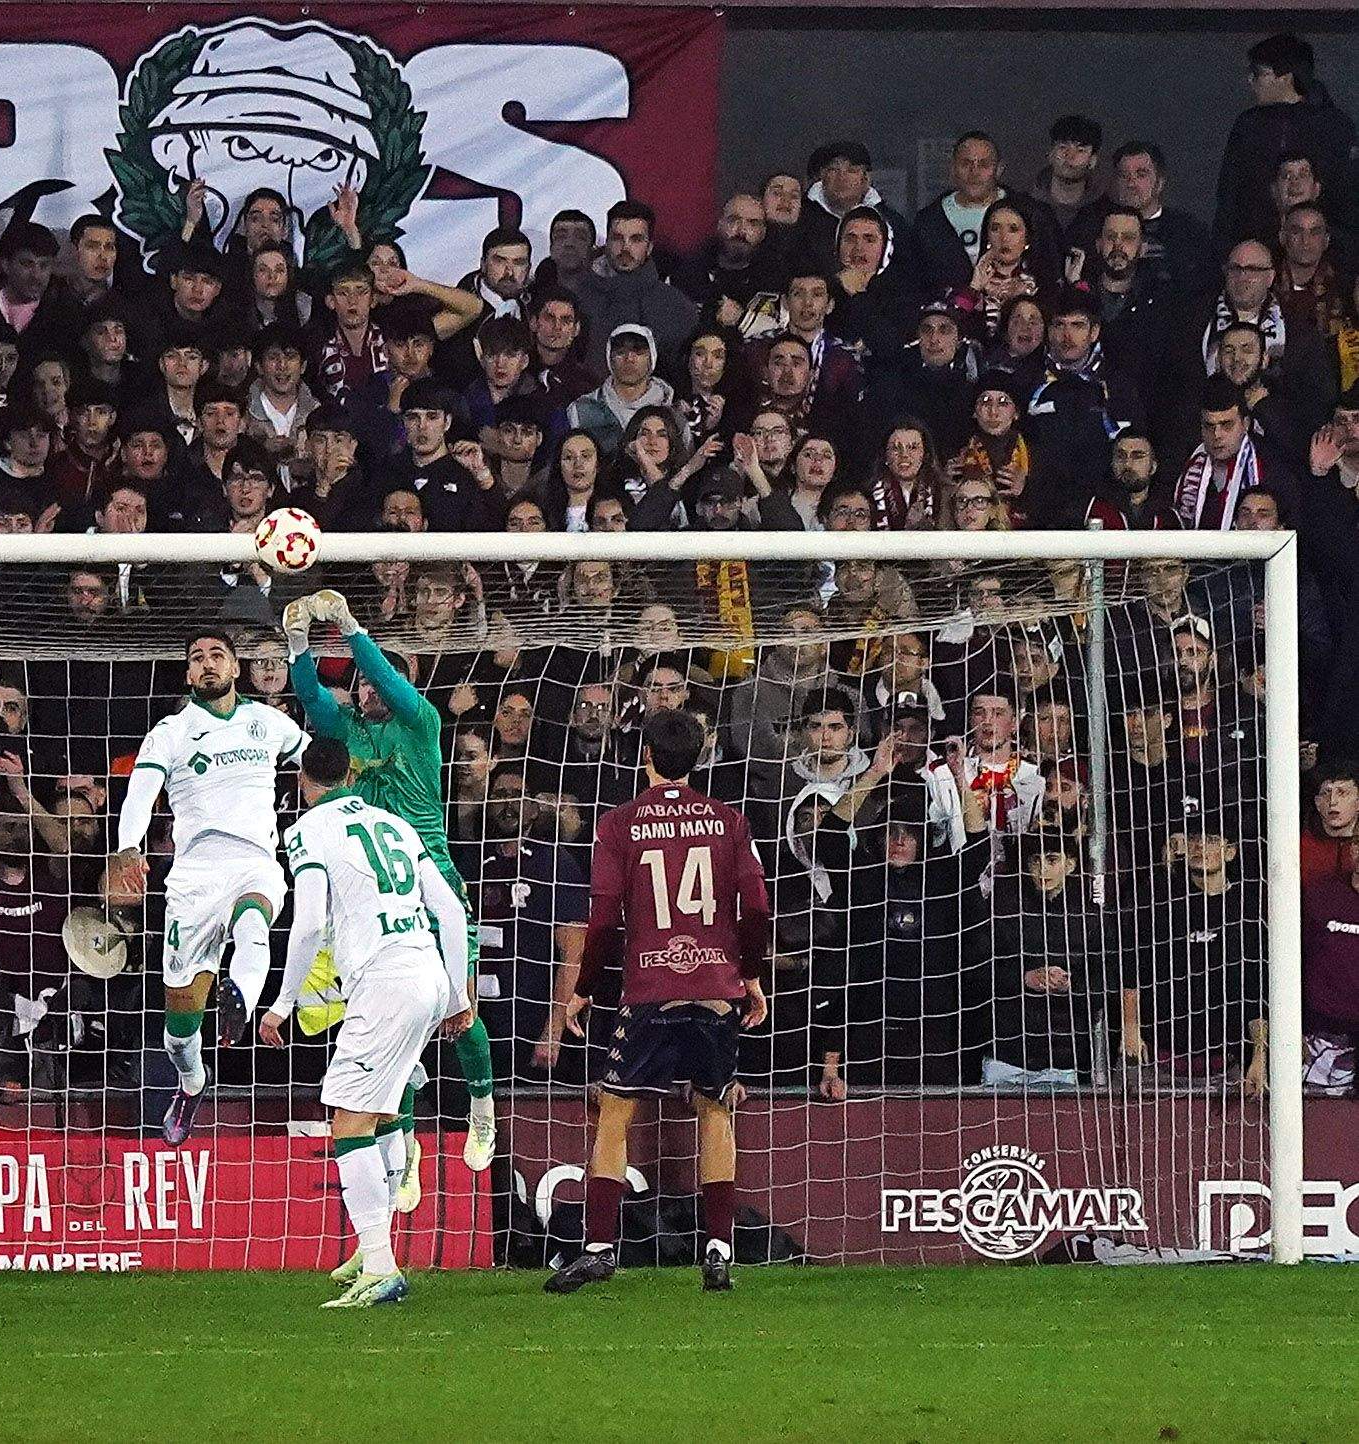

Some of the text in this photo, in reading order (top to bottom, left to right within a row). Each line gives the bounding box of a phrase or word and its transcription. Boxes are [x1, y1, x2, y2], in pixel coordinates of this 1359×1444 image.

[630, 819, 725, 841] SAMU MAYO
[346, 822, 415, 895] 16
[639, 846, 717, 930] 14
[167, 919, 180, 951] 4
[962, 1144, 1046, 1171] CONSERVAS
[68, 1220, 107, 1232] DEL
[123, 1150, 210, 1231] REY
[880, 1188, 1149, 1233] PESCAMAR
